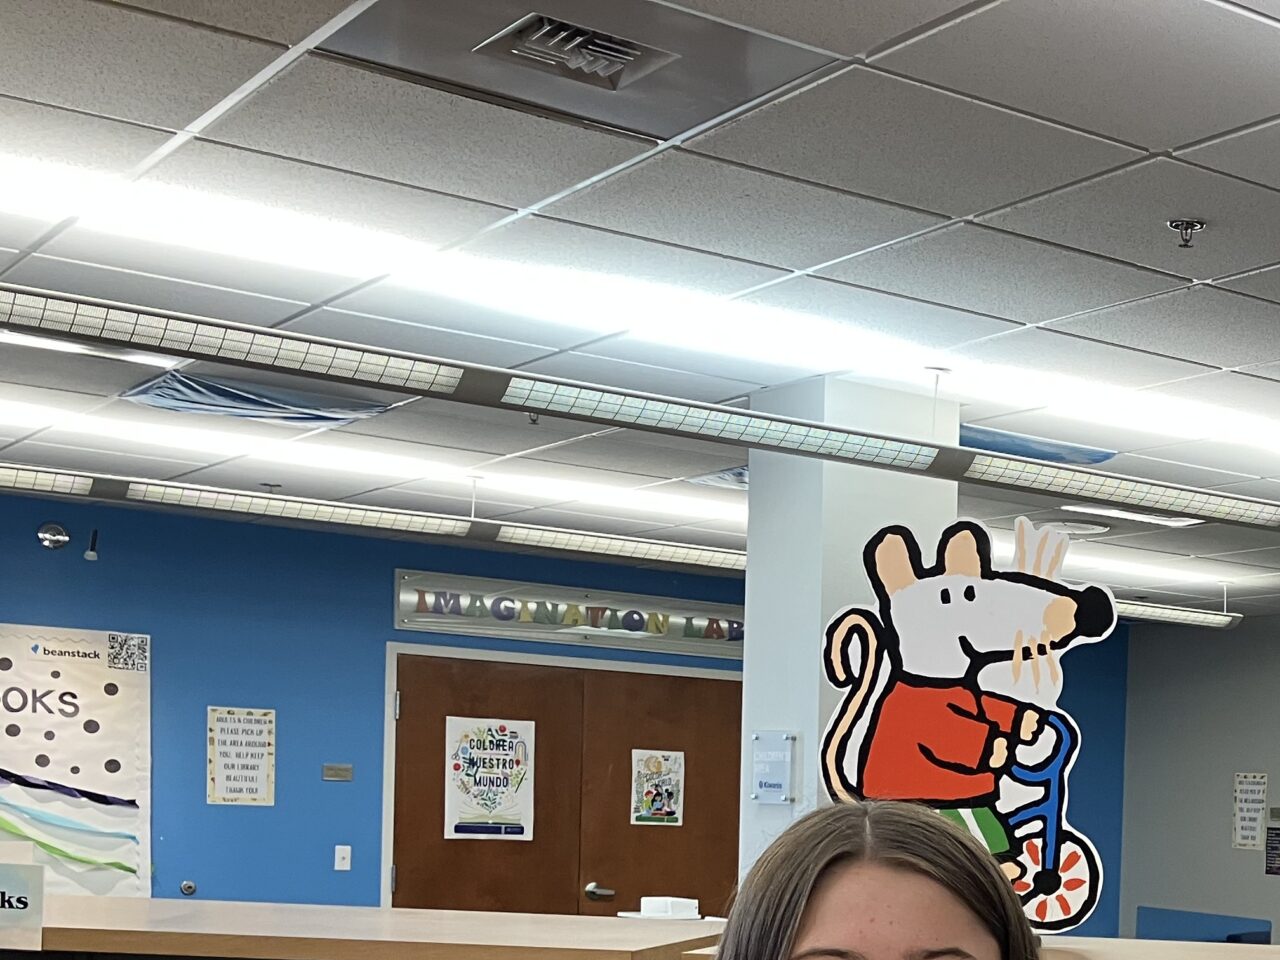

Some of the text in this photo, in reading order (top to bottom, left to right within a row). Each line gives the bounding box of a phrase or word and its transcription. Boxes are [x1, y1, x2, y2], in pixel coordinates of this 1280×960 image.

[415, 588, 670, 635] IMAGINATION
[43, 647, 100, 659] beanstack
[0, 686, 80, 718] OKS
[469, 738, 514, 751] COLOREA
[473, 776, 509, 787] MUNDO
